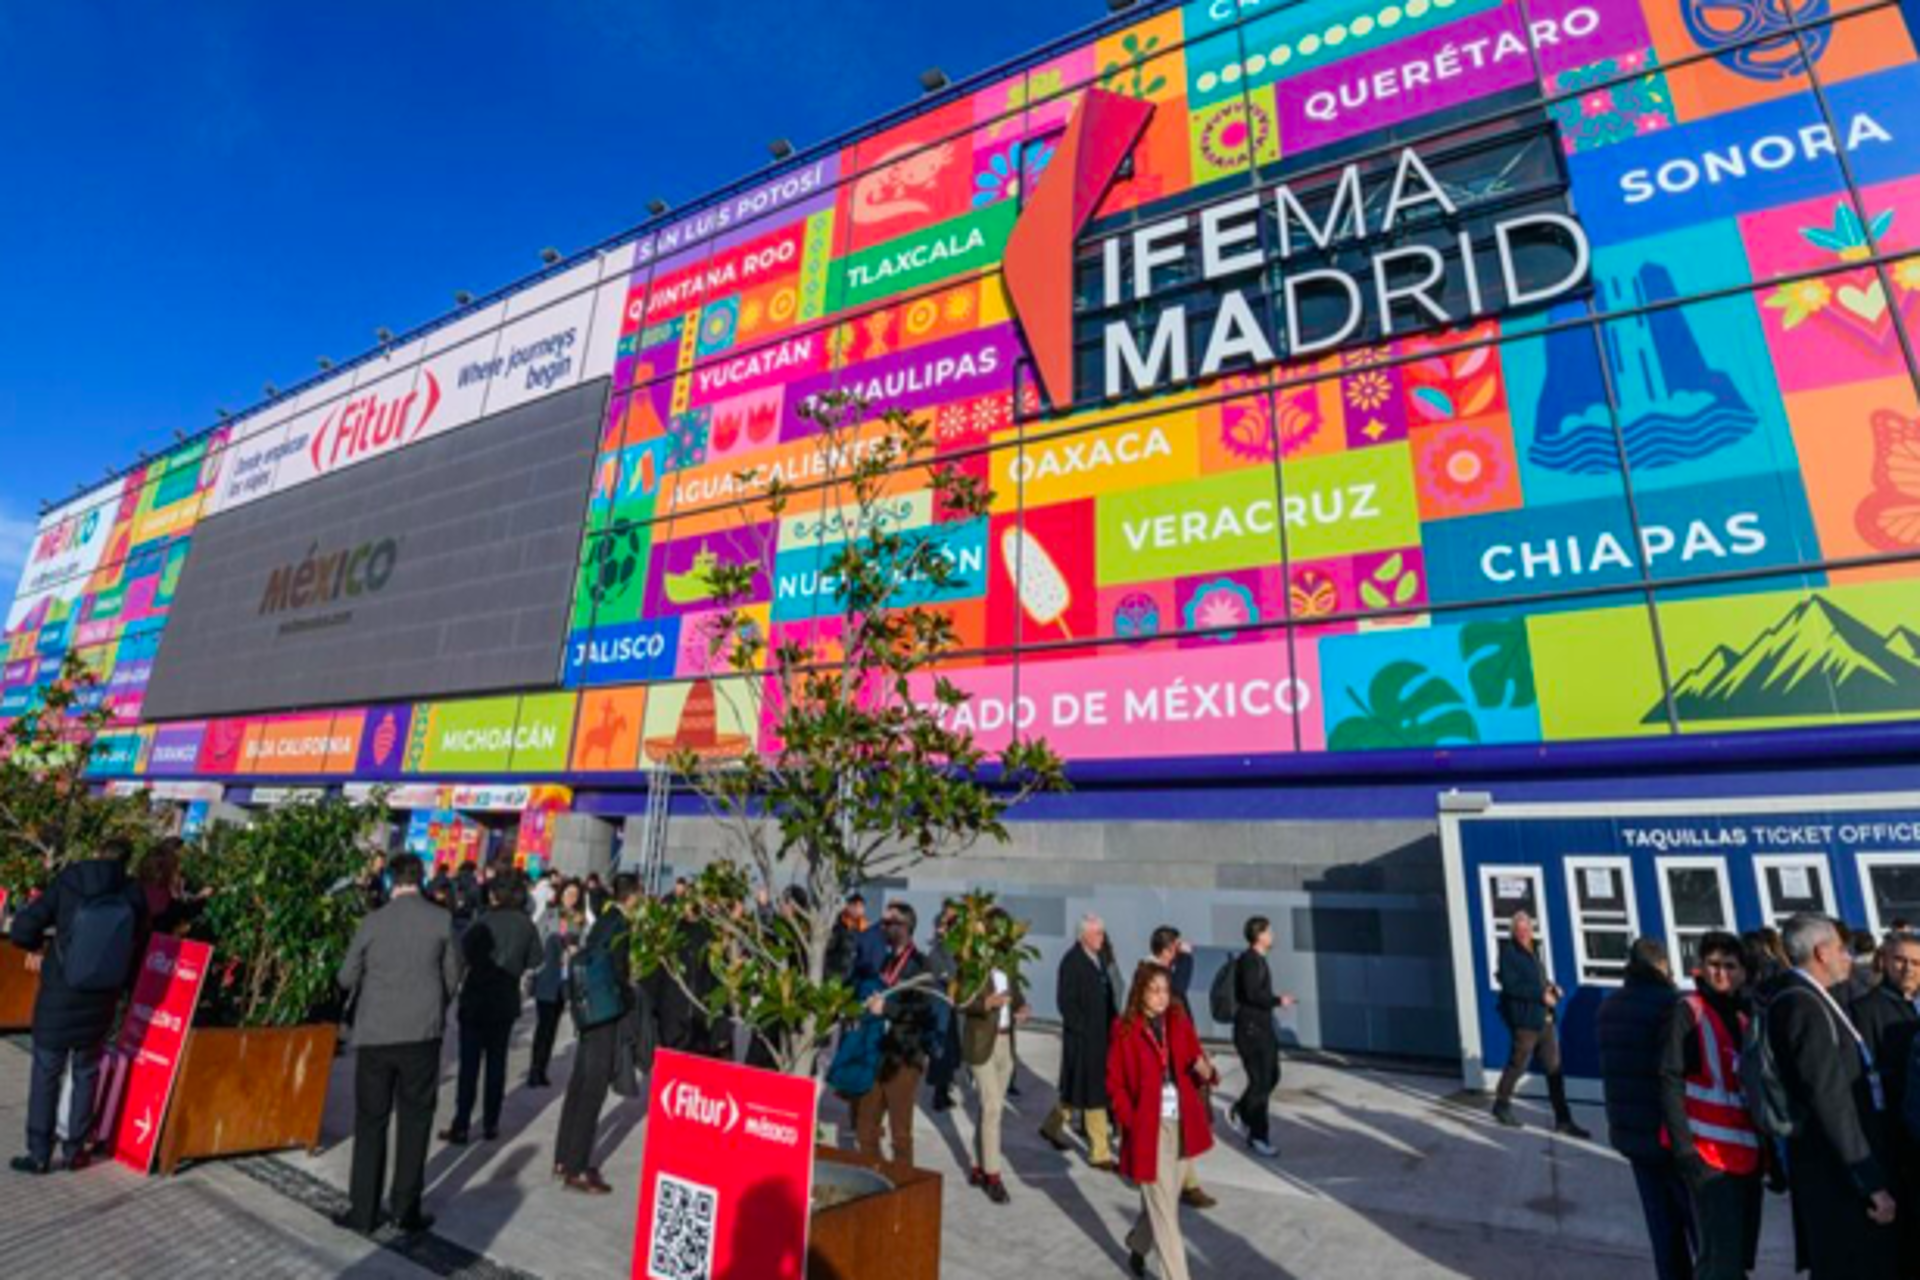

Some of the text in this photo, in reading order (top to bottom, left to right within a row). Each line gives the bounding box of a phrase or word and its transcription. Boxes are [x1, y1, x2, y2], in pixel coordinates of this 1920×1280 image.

[1304, 8, 1600, 121] QUERÉTARO
[1620, 113, 1892, 203] SONORA
[684, 202, 730, 242] LUIS
[736, 160, 824, 224] POTOSÍ
[1103, 147, 1456, 308] IFEMA
[743, 240, 796, 274] ROO
[846, 228, 986, 289] TLAXCALA
[1103, 213, 1591, 400] MADRID
[699, 338, 812, 393] YUCATÁN
[806, 346, 998, 416] TAULIPAS
[1008, 427, 1172, 483] OAXACA
[1122, 483, 1381, 552] VERACRUZ
[1480, 512, 1767, 582] CHIAPAS
[573, 632, 665, 666] JALISCO
[1051, 691, 1108, 727] DE
[1124, 675, 1310, 724] MÉXICO
[277, 737, 351, 756] CALIFORNIA
[441, 720, 557, 752] MICHOACÁN
[1622, 828, 1747, 850] TAQUILLAS
[1752, 825, 1833, 845] TICKET
